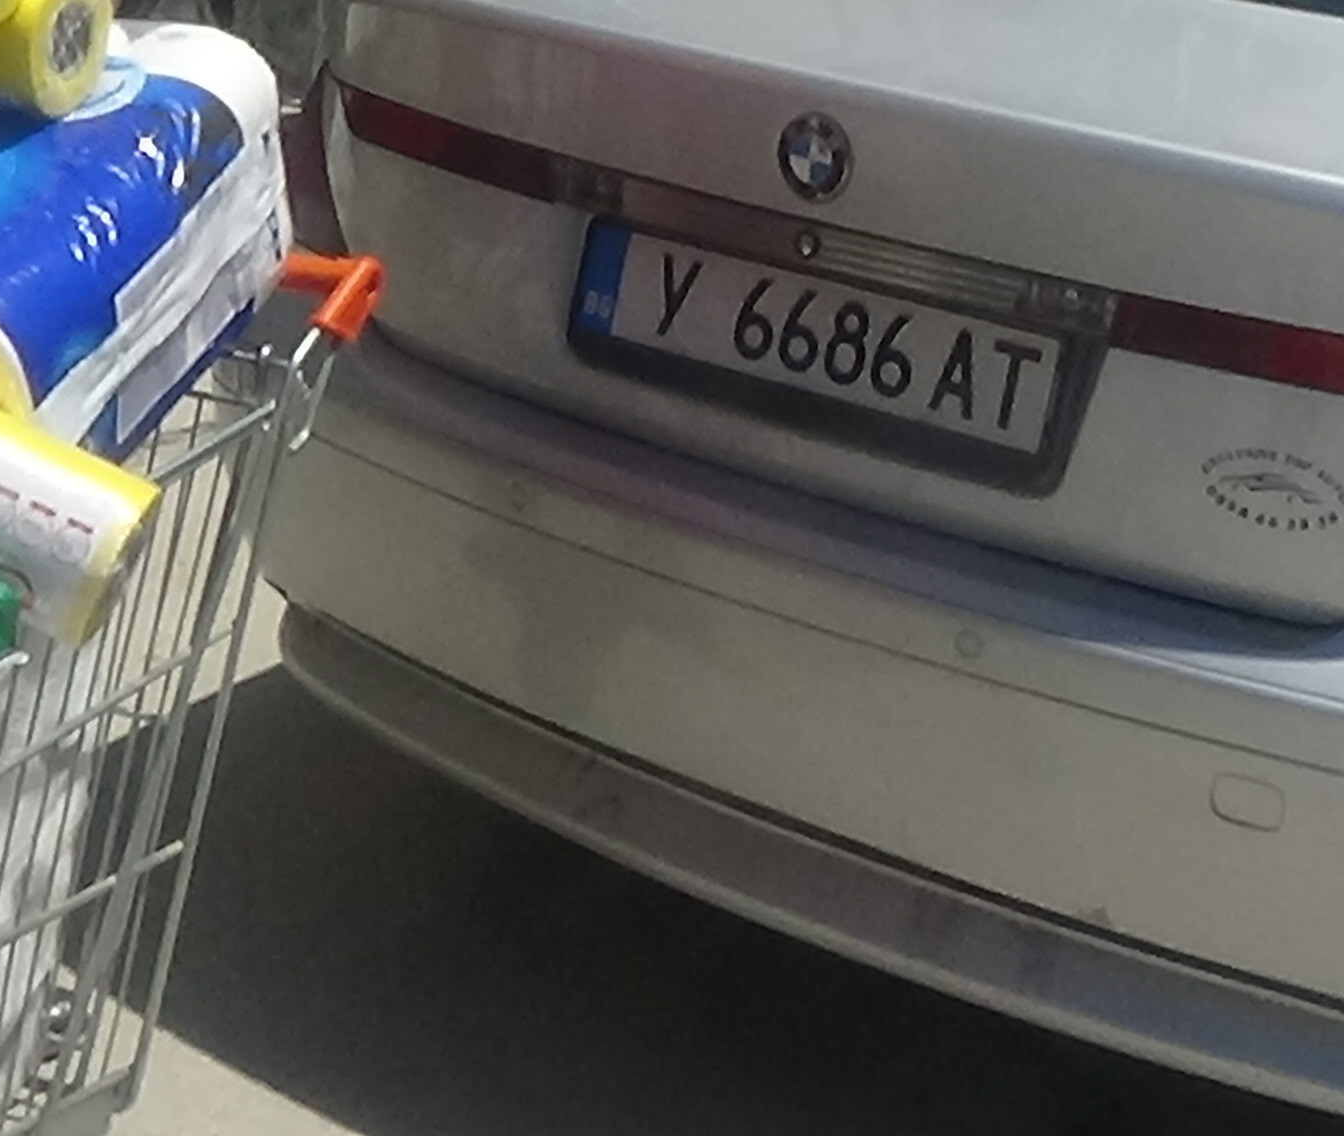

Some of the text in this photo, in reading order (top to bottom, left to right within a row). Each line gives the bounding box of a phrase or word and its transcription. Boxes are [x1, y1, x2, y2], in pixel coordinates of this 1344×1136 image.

[583, 290, 612, 318] BG
[734, 277, 915, 398] 6686
[928, 327, 1043, 430] AT
